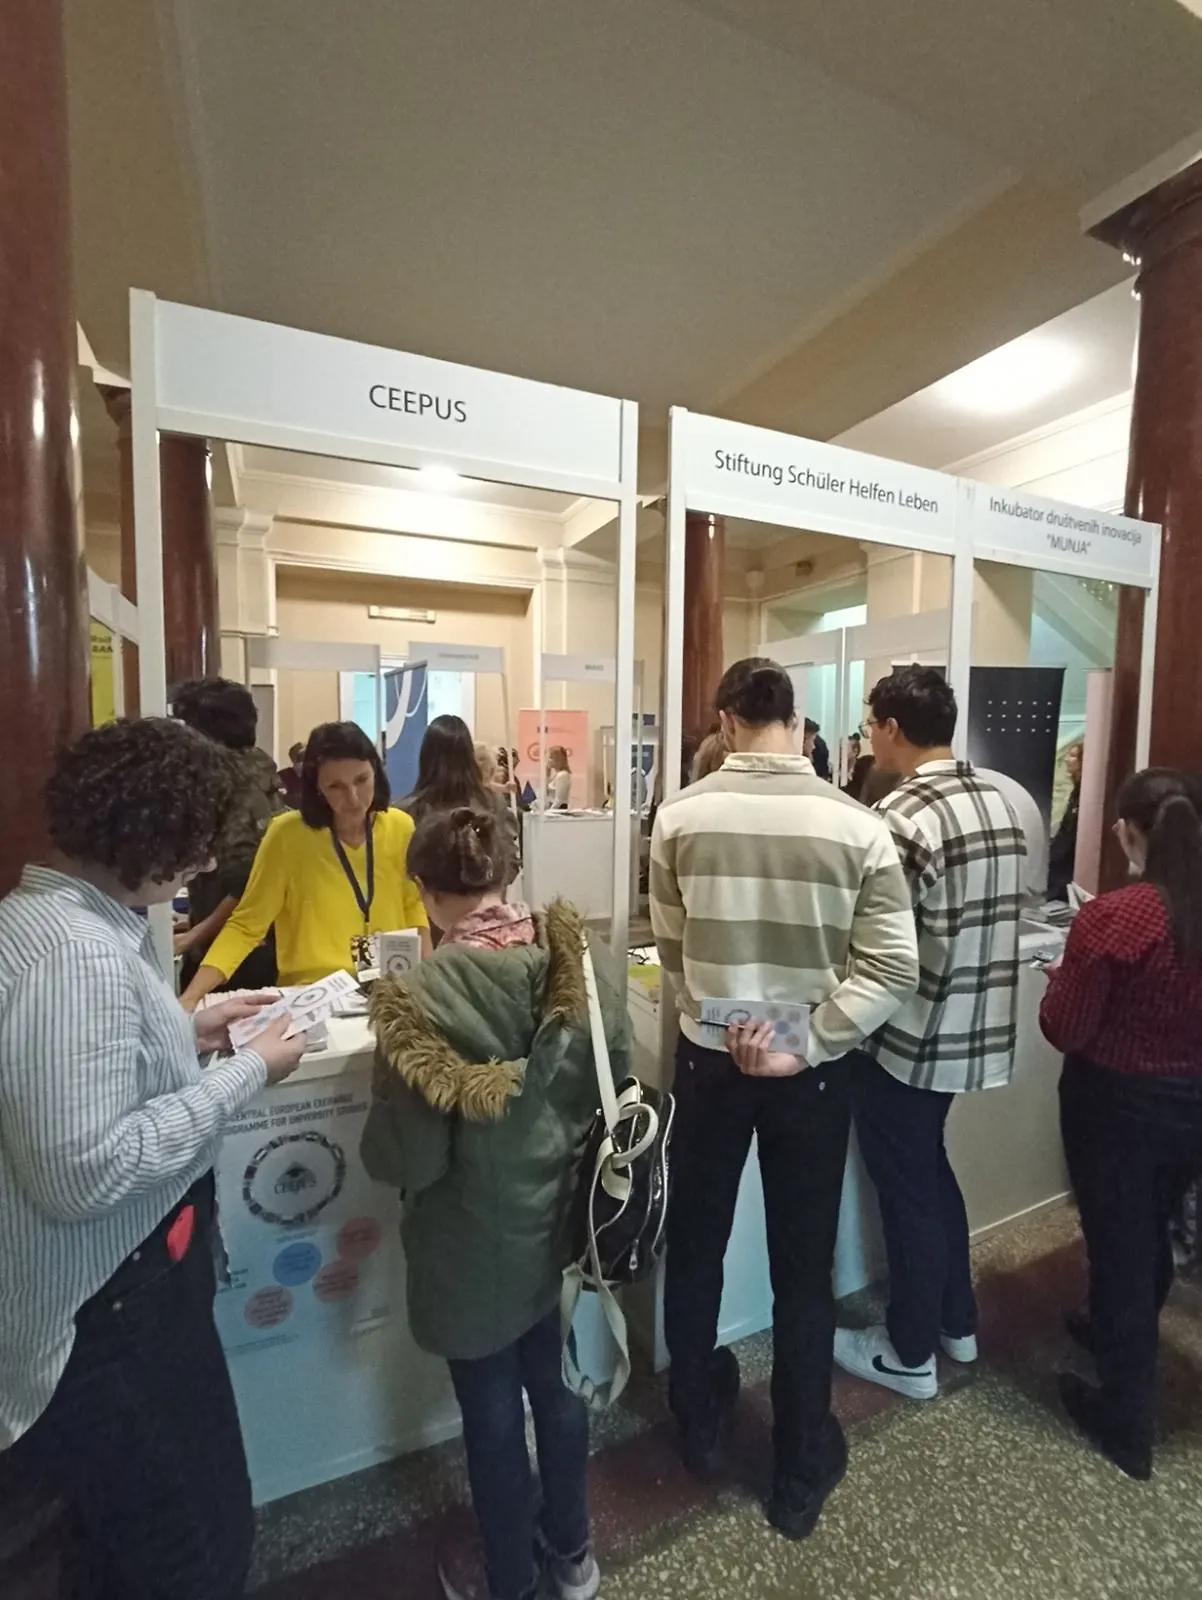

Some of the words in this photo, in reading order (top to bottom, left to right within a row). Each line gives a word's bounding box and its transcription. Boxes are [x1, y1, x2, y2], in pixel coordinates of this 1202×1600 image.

[368, 384, 467, 423] CEEPUS
[714, 450, 783, 485] Stiftung
[788, 465, 845, 494] Schüler
[849, 478, 895, 504] Helfen
[898, 490, 939, 513] Leben
[989, 497, 1044, 520] Inkubator
[1046, 511, 1100, 534] društvenih
[1101, 523, 1142, 546] inovacija
